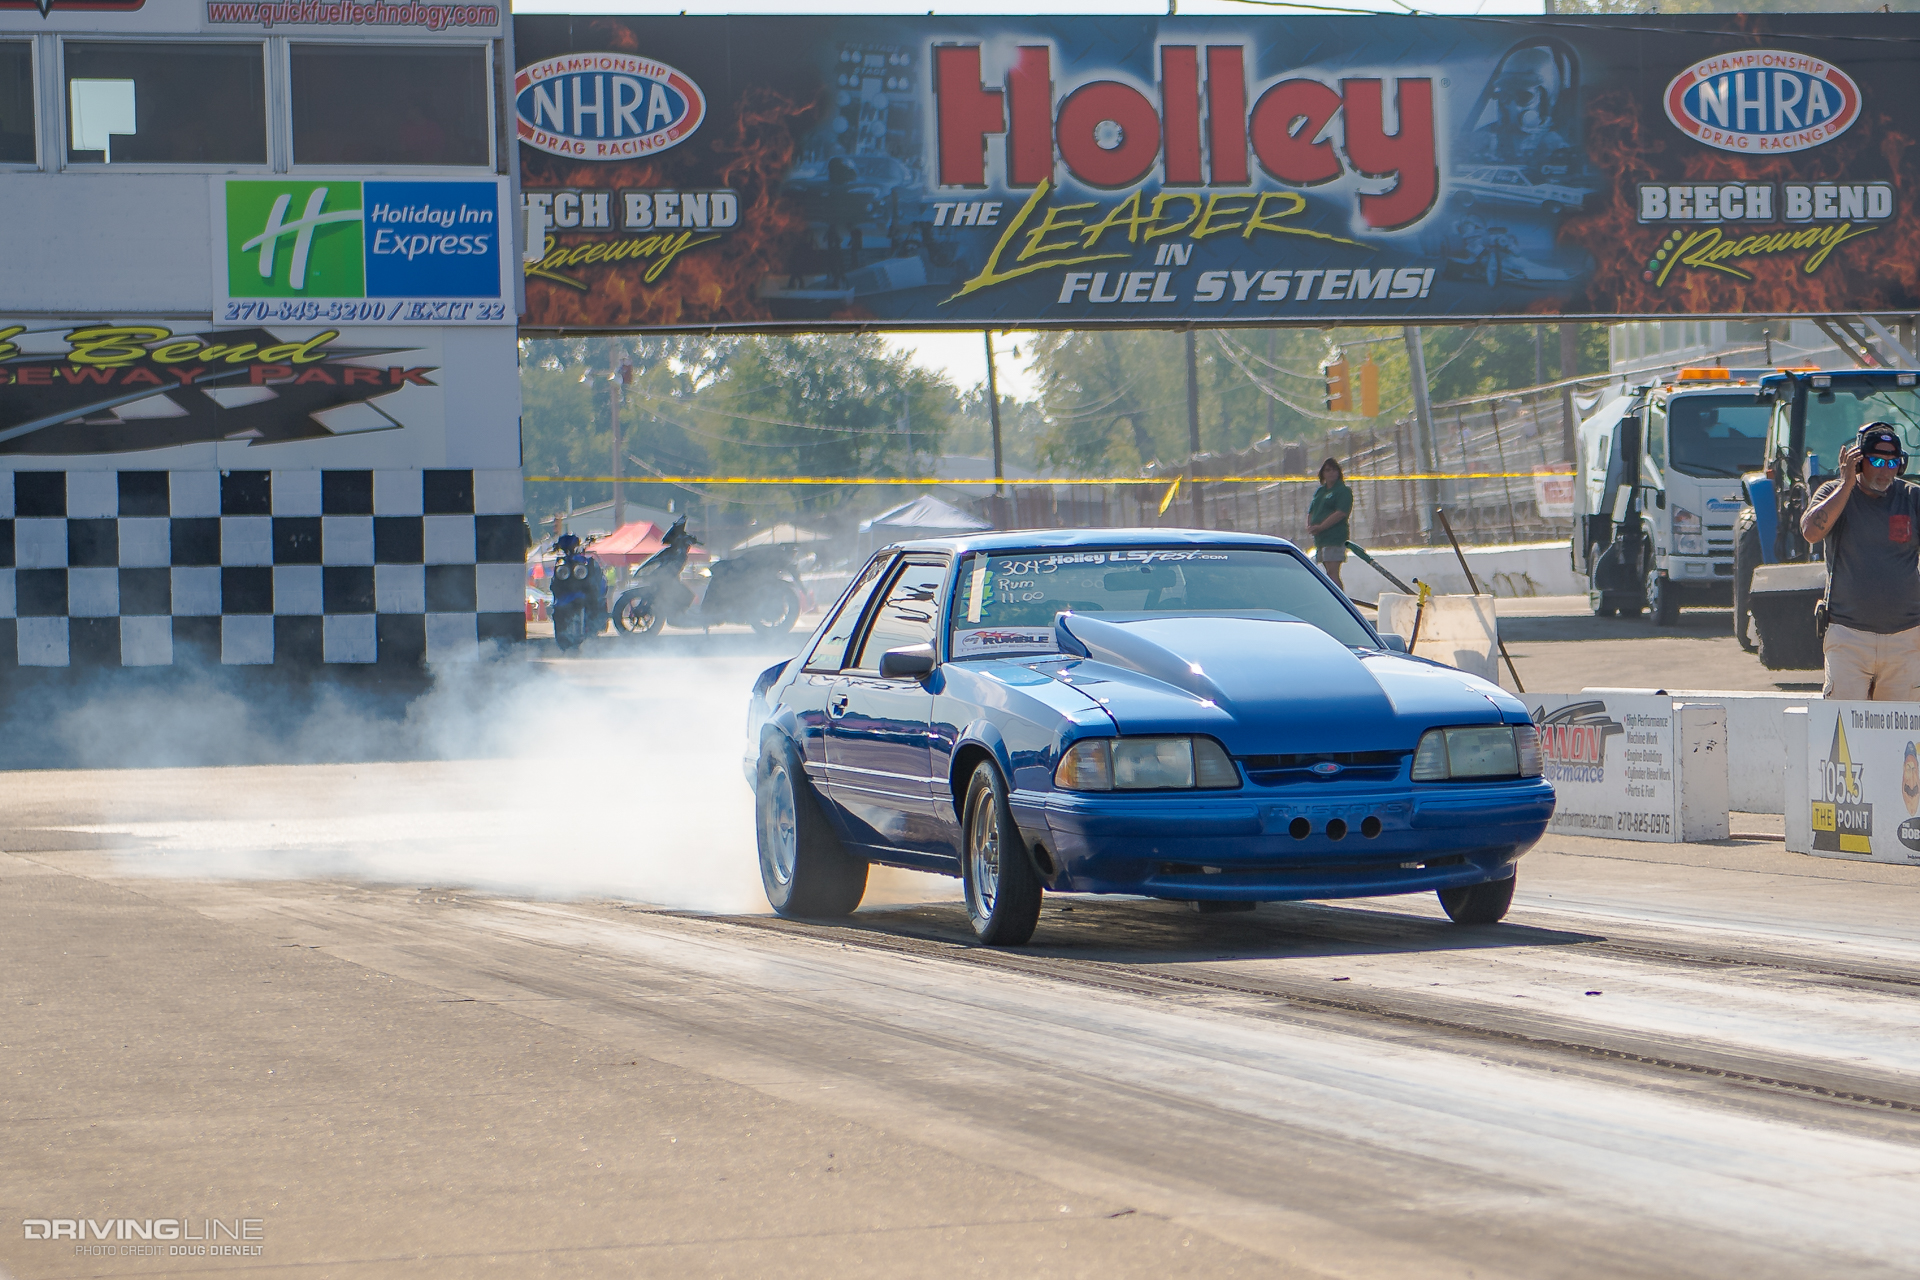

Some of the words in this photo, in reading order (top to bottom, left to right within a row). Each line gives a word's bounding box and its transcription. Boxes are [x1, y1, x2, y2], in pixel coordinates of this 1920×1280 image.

[208, 0, 498, 30] www.quickfueltechnology.com
[532, 57, 666, 81] CHAMPIONSHIP
[1698, 54, 1824, 77] CHAMPIONSHIP
[534, 75, 674, 138] NHRA
[1699, 72, 1831, 131] NHRA
[535, 132, 586, 155] DRAG
[598, 134, 666, 156] RACING
[935, 45, 1439, 230] Holley
[1702, 127, 1749, 149] DRAG
[1760, 128, 1824, 150] RACING
[624, 192, 739, 228] BEND
[1640, 185, 1773, 220] BEECH
[1786, 185, 1893, 220] BEND
[371, 203, 456, 228] Holiday
[458, 204, 493, 223] Inn
[933, 202, 1003, 228] THE
[372, 228, 489, 262] Express
[937, 176, 1379, 307] LEADER
[1155, 243, 1194, 267] IN
[1656, 222, 1879, 288] Raceway
[1058, 271, 1178, 305] FUEL
[1193, 267, 1437, 304] SYSTEMS!
[224, 300, 386, 322] 270-843-3200
[403, 300, 475, 321] EXIT
[475, 300, 507, 321] 22
[65, 325, 341, 367] Bend
[0, 365, 206, 386] EWAY
[248, 364, 441, 387] PARK
[998, 558, 1058, 577] 3043
[982, 635, 1050, 646] RUMBLE
[1638, 713, 1669, 728] Performance
[1850, 709, 1864, 729] The
[1864, 709, 1885, 730] Home
[1886, 710, 1894, 730] of
[1894, 710, 1908, 731] Bob
[1535, 725, 1602, 763] ANON
[1626, 731, 1646, 745] Machine
[1646, 731, 1659, 745] Work
[1627, 748, 1642, 765] Engine
[1643, 749, 1663, 766] Building
[1627, 766, 1646, 783] Cylinder
[1647, 766, 1659, 780] Head
[1659, 767, 1672, 781] Work
[1820, 759, 1864, 805] 105.3
[1627, 783, 1641, 797] Parts
[1645, 784, 1656, 798] Fuel
[1617, 811, 1671, 835] 270-825-0976
[1814, 808, 1833, 827] THE
[1837, 809, 1869, 830] POINT
